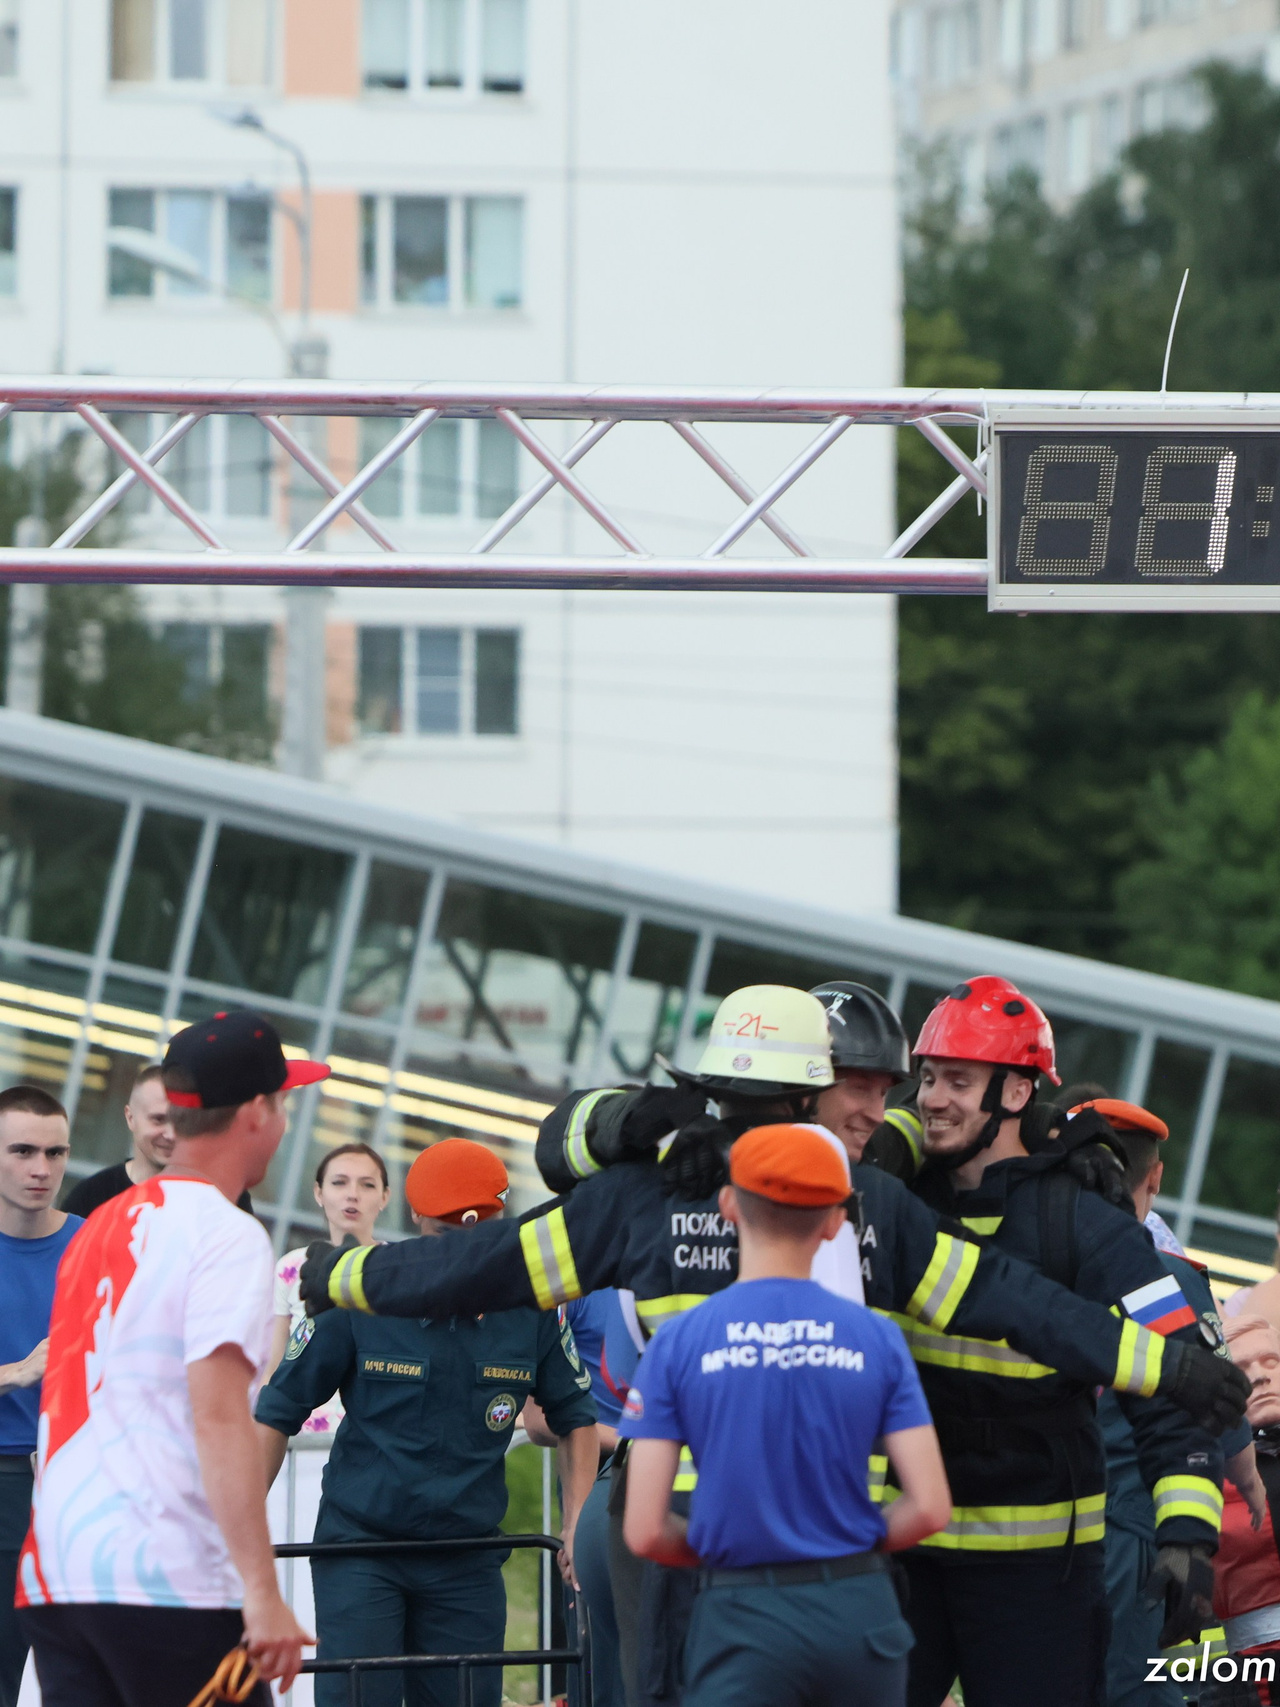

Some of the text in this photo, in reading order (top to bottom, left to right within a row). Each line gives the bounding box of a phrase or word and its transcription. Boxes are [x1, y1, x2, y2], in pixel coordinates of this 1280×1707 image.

[671, 1213, 738, 1237] ПОЖА
[673, 1244, 738, 1271] САНК
[726, 1319, 836, 1347] КАДЕТЫ
[364, 1360, 421, 1376] МЧС РОССИИ
[700, 1344, 865, 1374] МЧС РОССИИ
